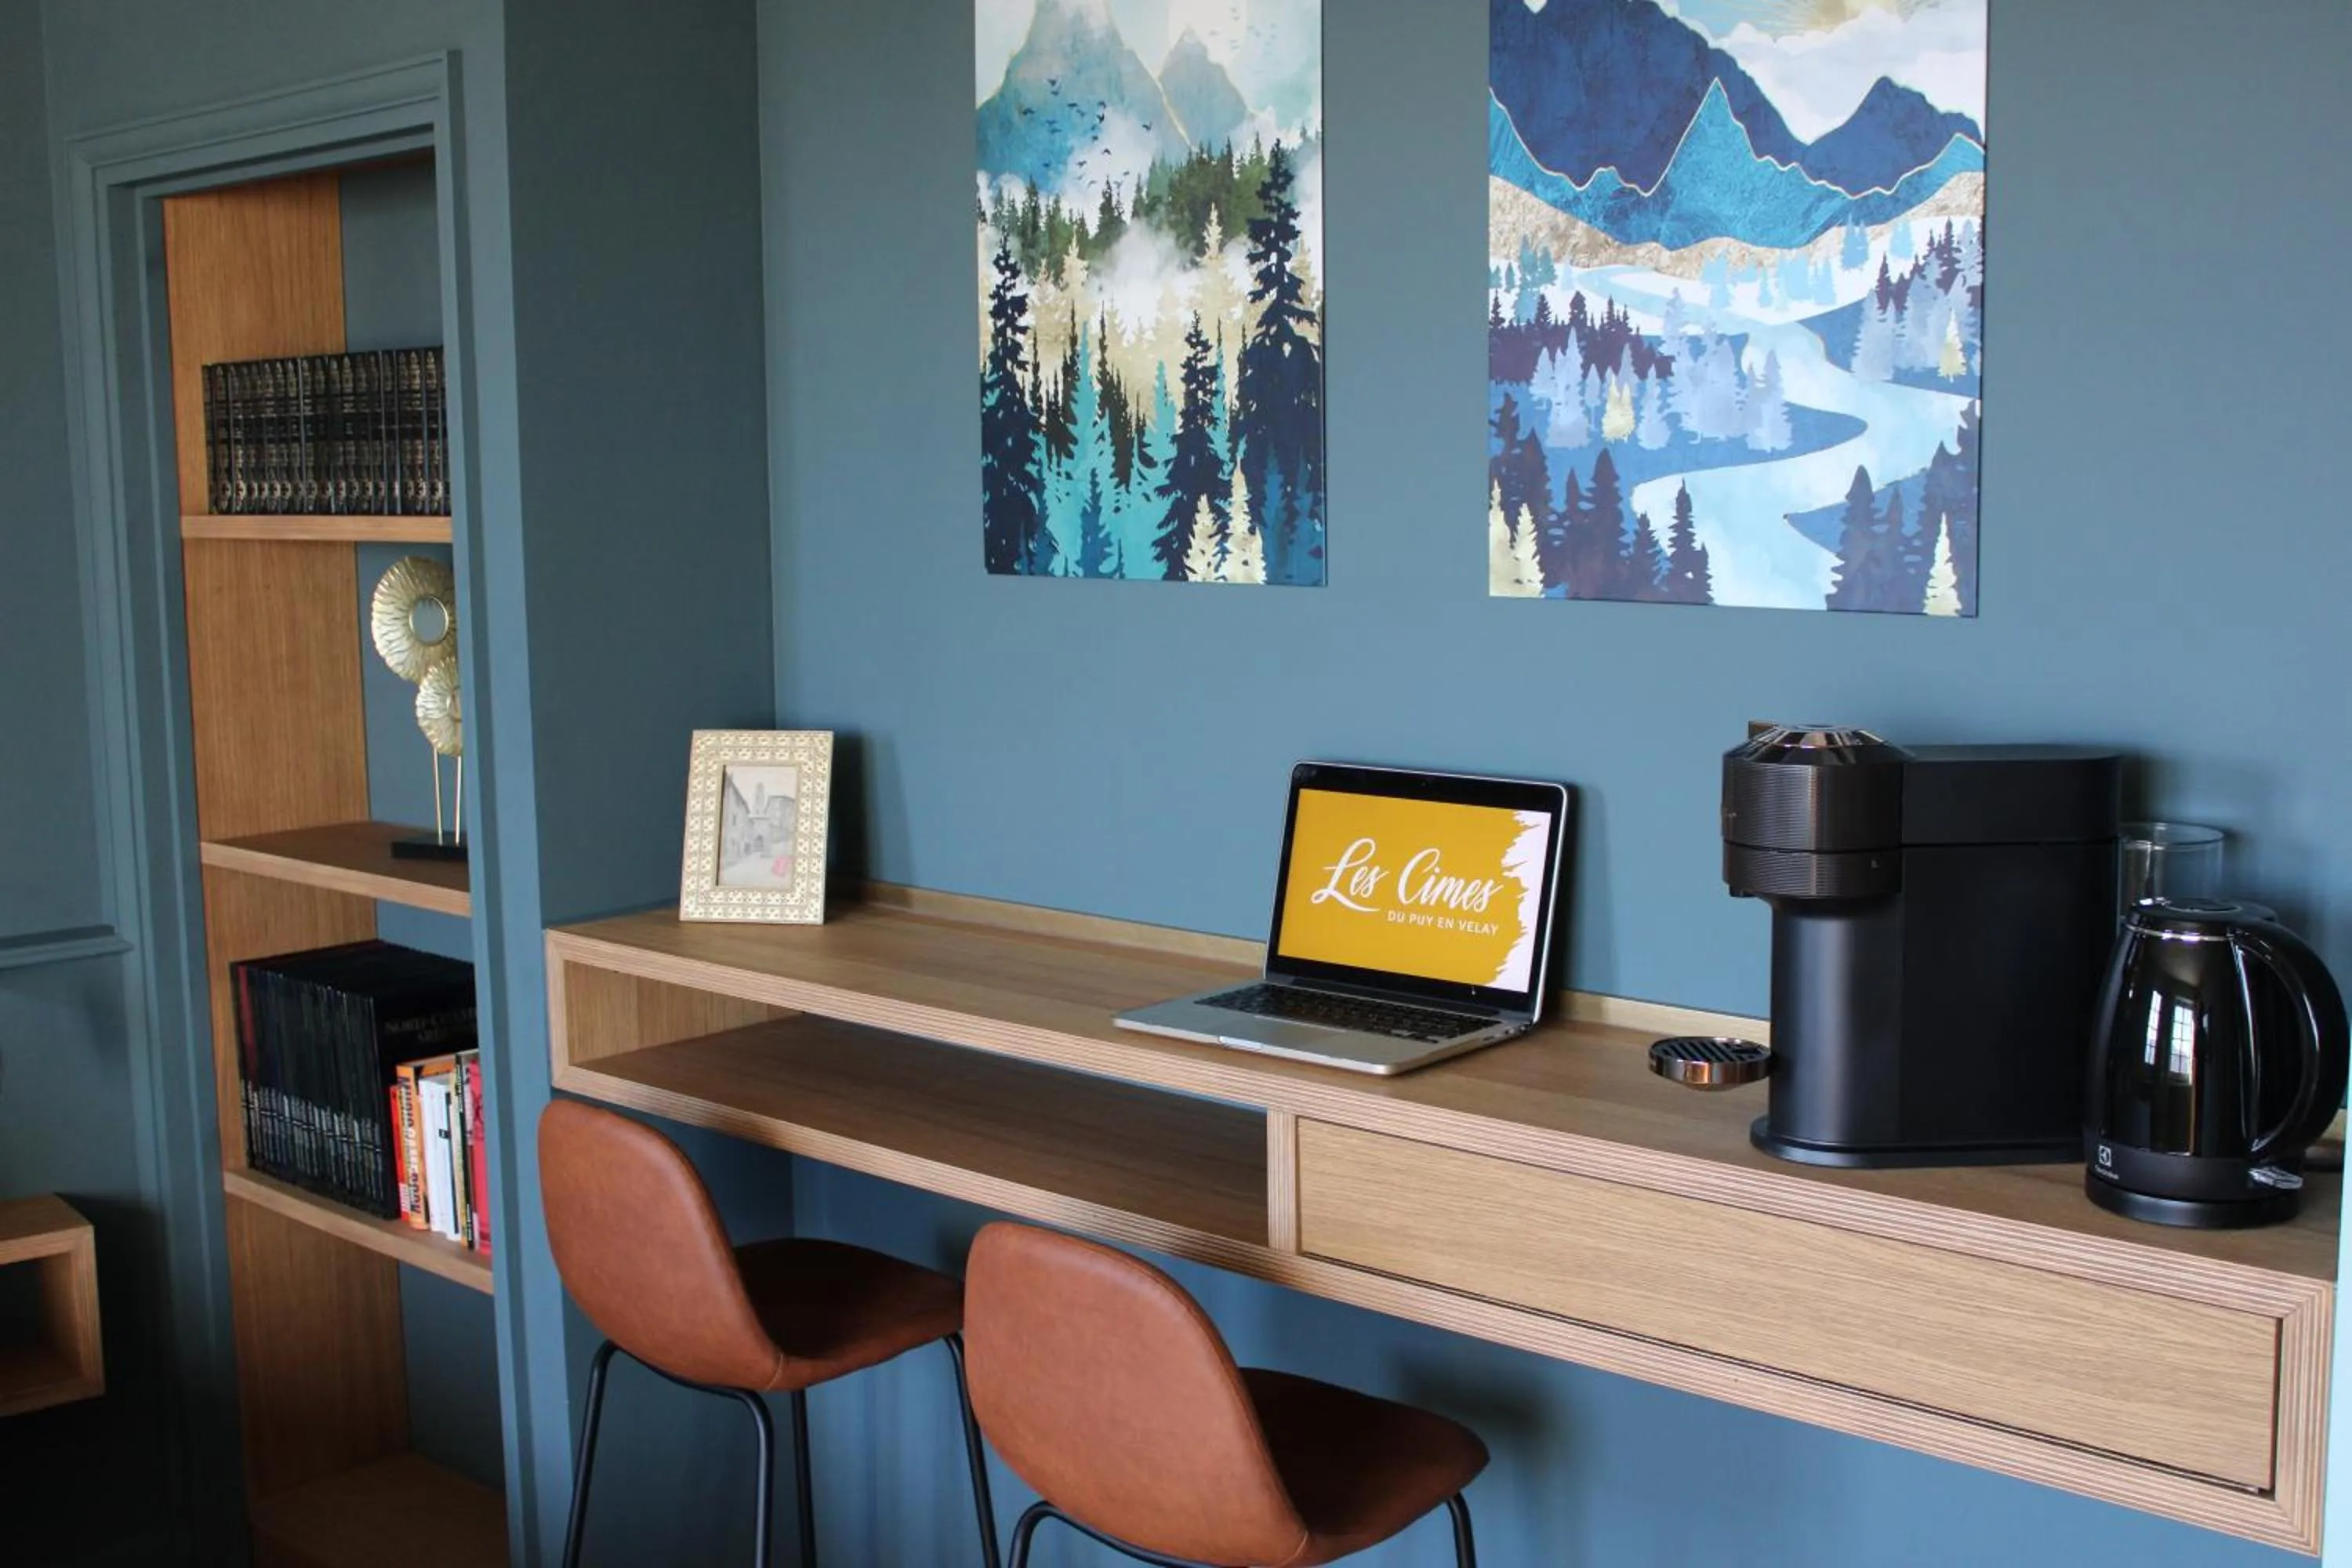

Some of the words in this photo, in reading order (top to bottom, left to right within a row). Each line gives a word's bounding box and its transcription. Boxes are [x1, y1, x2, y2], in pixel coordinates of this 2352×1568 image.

[1311, 837, 1390, 912] Les
[1398, 848, 1504, 913] Cimes
[1388, 909, 1405, 922] DU
[1409, 913, 1435, 927] PUY
[1438, 917, 1454, 929] EN
[1458, 920, 1498, 935] VELAY
